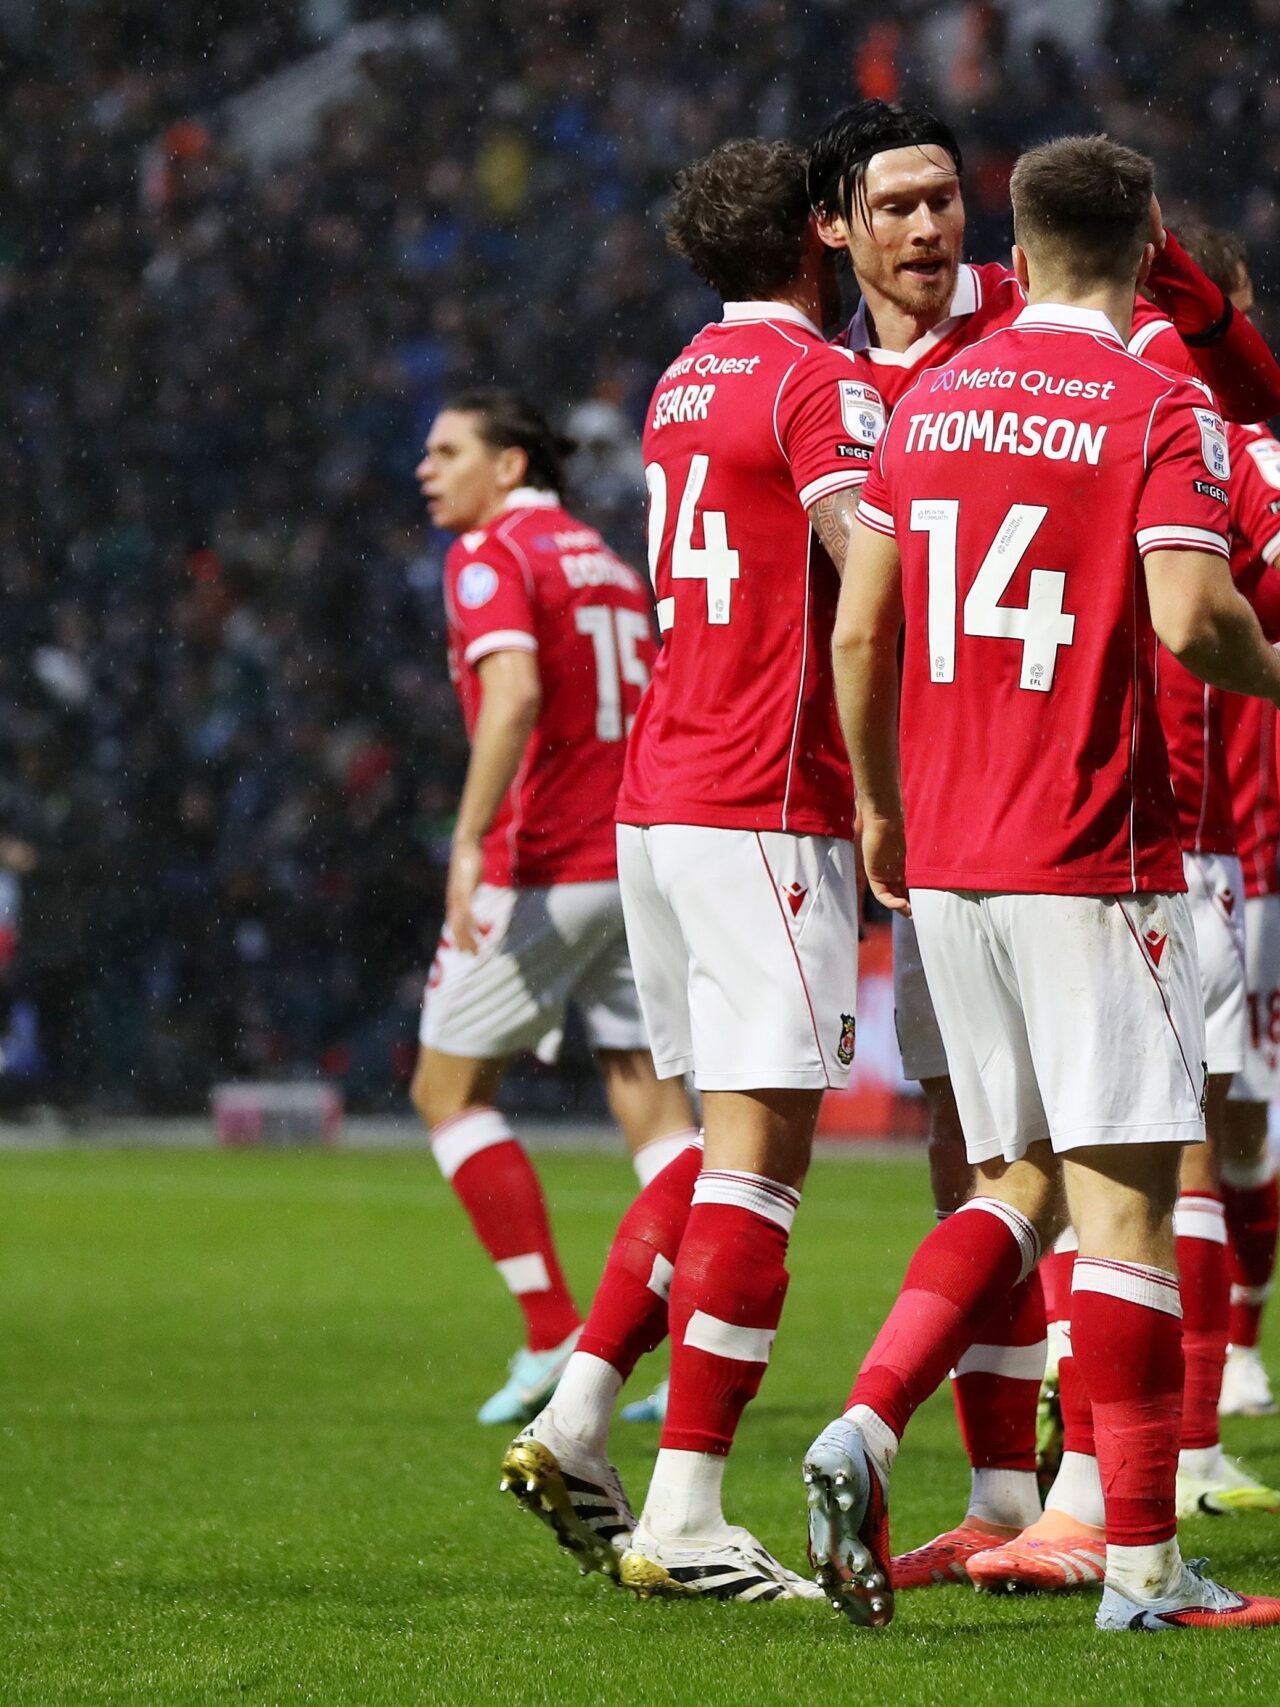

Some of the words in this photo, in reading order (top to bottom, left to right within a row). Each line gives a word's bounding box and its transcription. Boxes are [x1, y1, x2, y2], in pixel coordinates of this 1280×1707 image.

[695, 353, 761, 377] Quest
[954, 366, 1015, 391] Meta
[1019, 369, 1116, 400] Quest
[652, 384, 716, 430] SCARR
[862, 429, 876, 440] EFL
[904, 409, 1107, 465] THOMASON
[1213, 462, 1224, 473] EFL
[644, 454, 740, 632] 24
[909, 499, 1076, 692] 14
